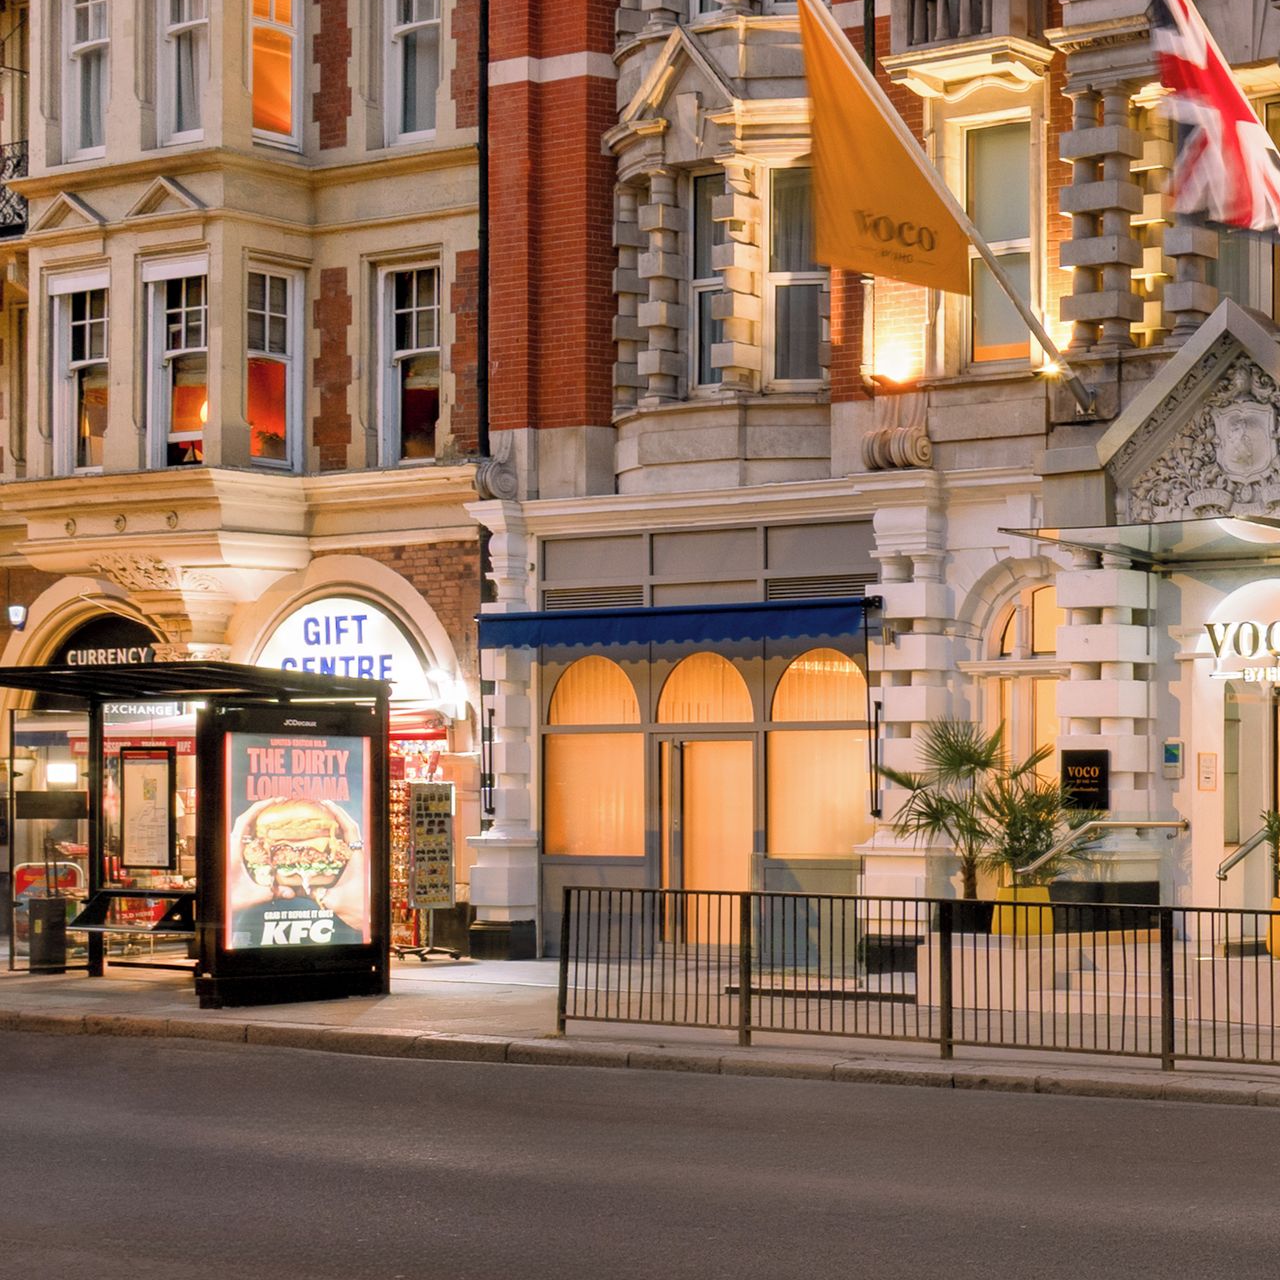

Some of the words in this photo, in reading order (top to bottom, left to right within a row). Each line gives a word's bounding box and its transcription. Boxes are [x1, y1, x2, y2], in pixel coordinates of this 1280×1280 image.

[303, 615, 368, 646] GIFT
[67, 647, 149, 666] CURRENCY
[103, 703, 173, 716] EXCHANGE
[247, 747, 286, 774] THE
[291, 749, 350, 775] DIRTY
[246, 775, 350, 801] LOUISIANA
[261, 919, 335, 945] KFC
